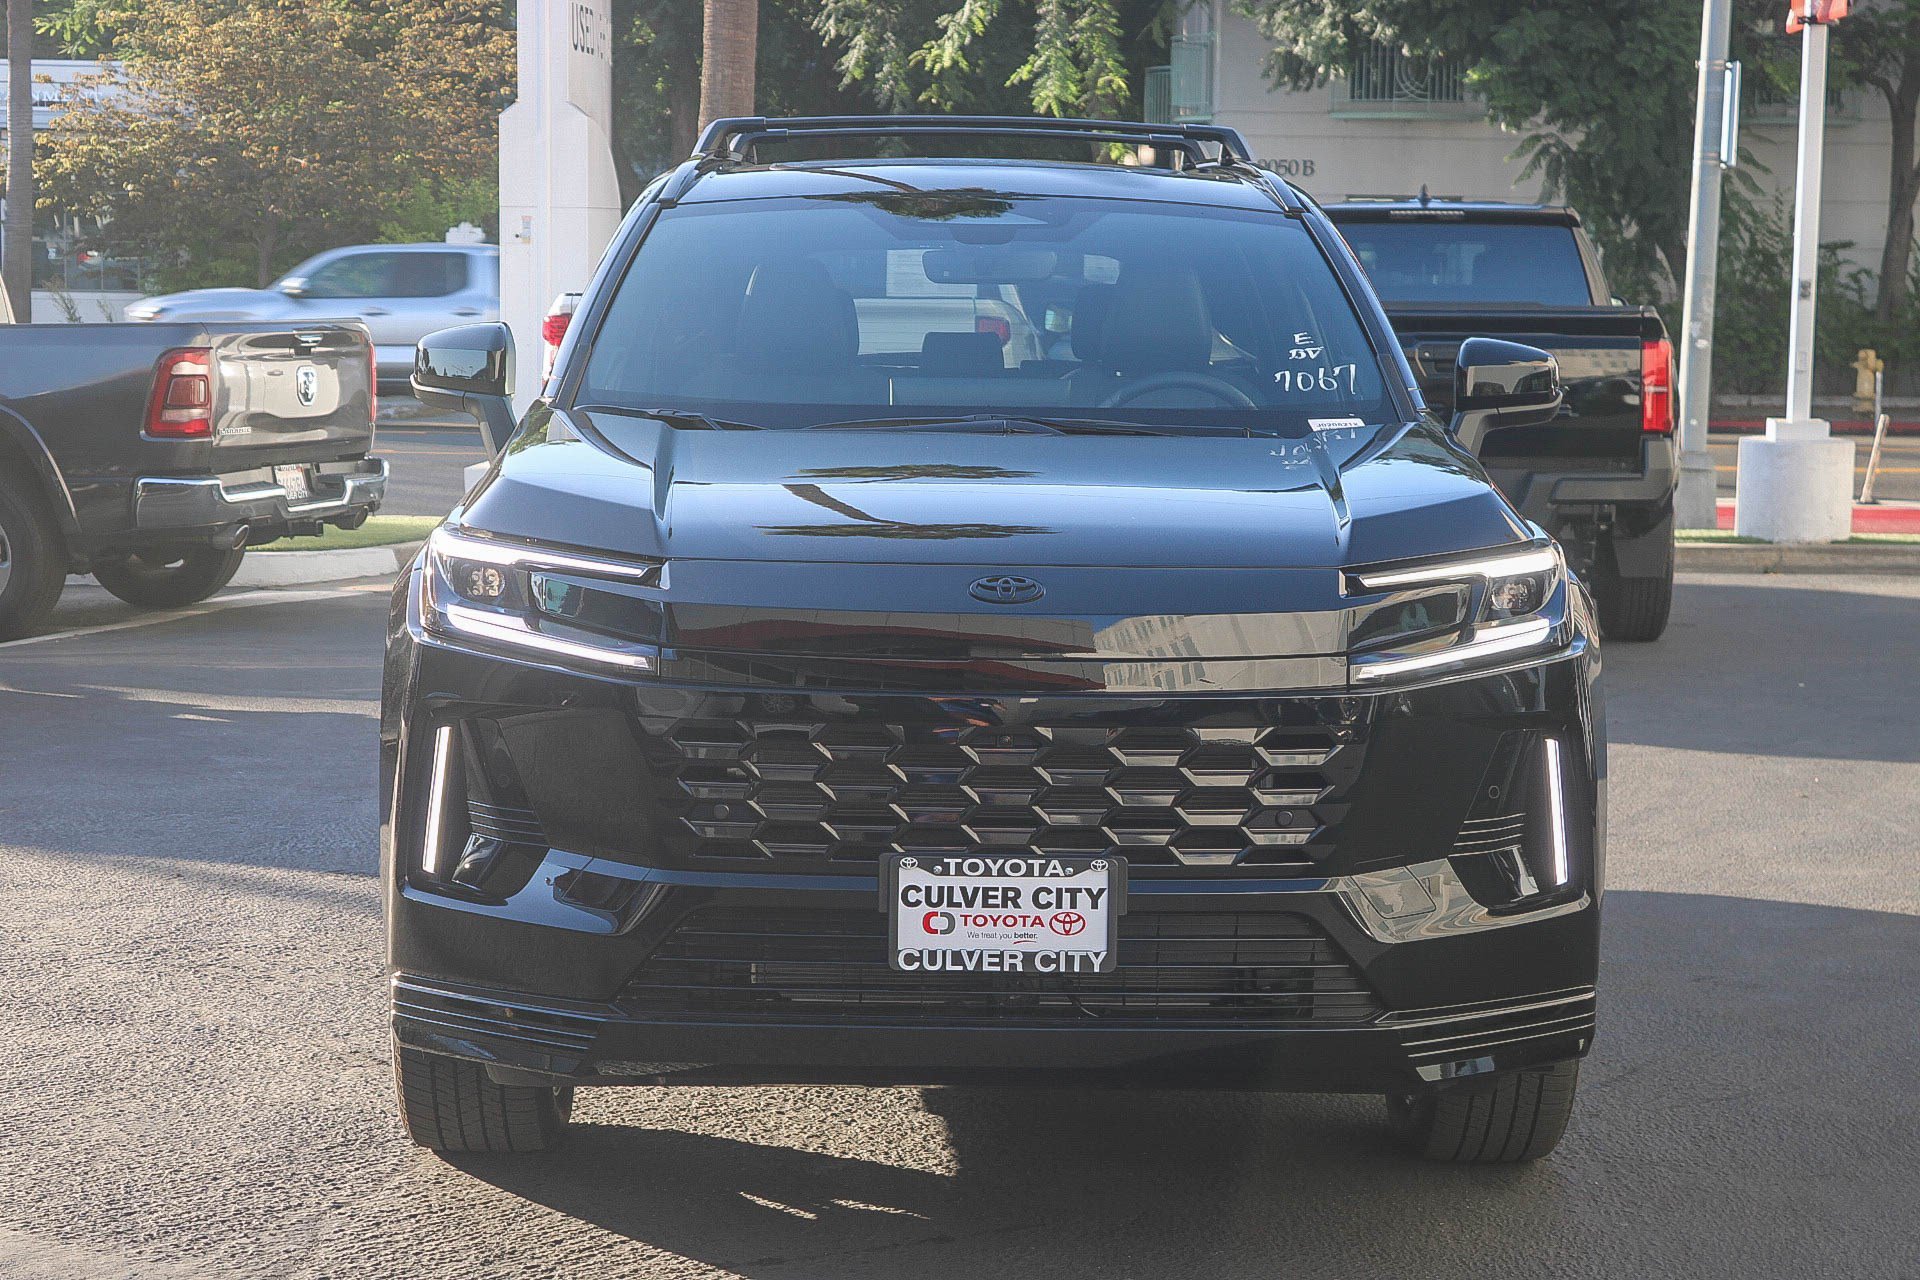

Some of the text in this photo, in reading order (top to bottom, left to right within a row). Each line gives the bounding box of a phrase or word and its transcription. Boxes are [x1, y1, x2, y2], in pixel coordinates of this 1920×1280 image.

[572, 2, 595, 55] USED
[1302, 159, 1315, 176] B
[1293, 332, 1314, 345] E
[943, 858, 1066, 877] TOYOTA
[900, 884, 1107, 910] CULVER CITY
[960, 914, 1046, 928] TOYOTA
[966, 931, 1038, 941] We treat you better.
[898, 948, 1108, 973] CULVER CITY
